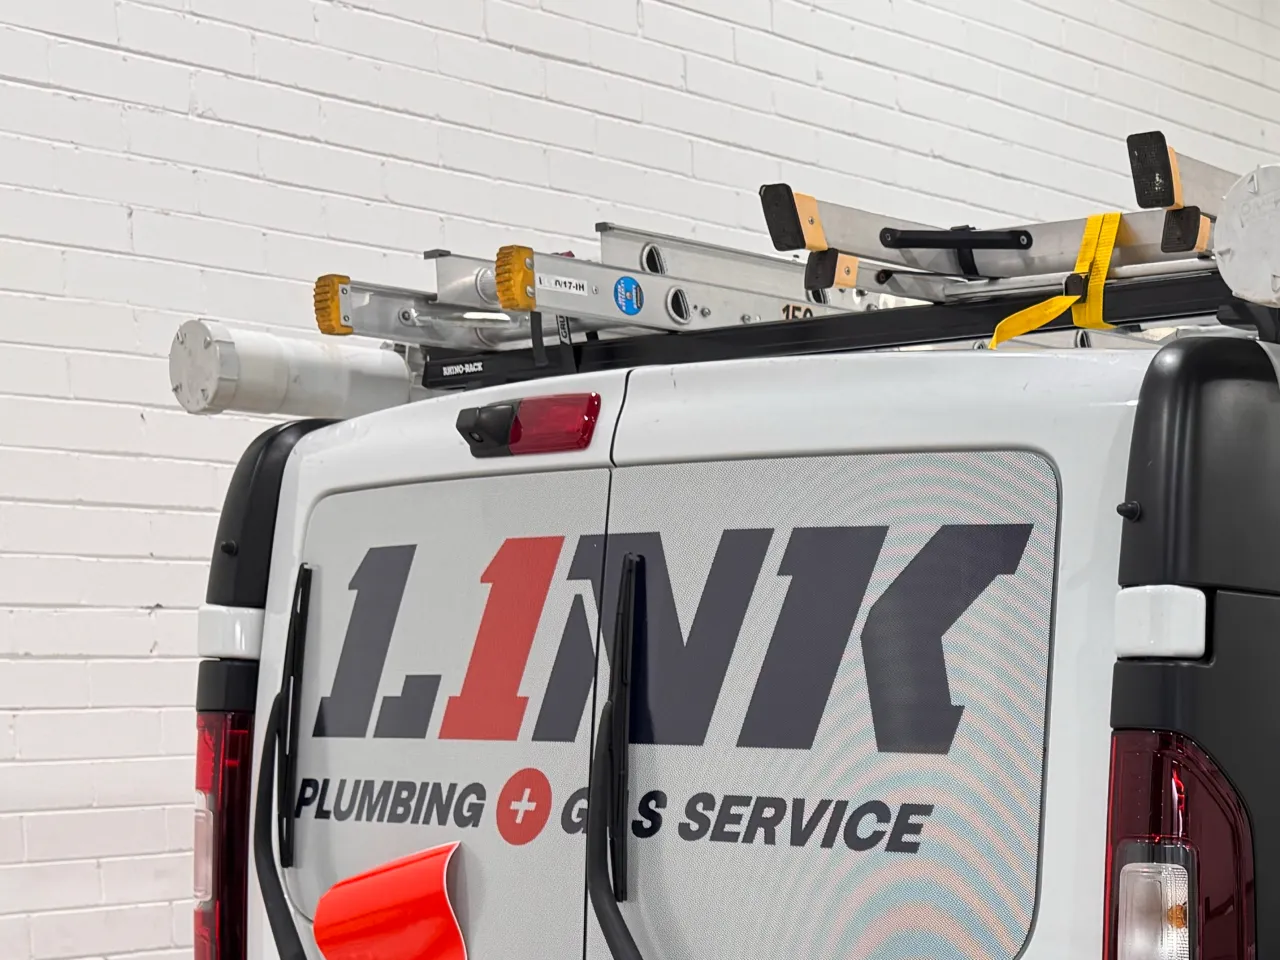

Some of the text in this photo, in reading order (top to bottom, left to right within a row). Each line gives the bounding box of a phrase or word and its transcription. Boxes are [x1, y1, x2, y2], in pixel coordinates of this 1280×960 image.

[442, 362, 483, 376] RHINO-RACK
[294, 778, 487, 828] PLUMBING
[678, 791, 935, 854] SERVICE
